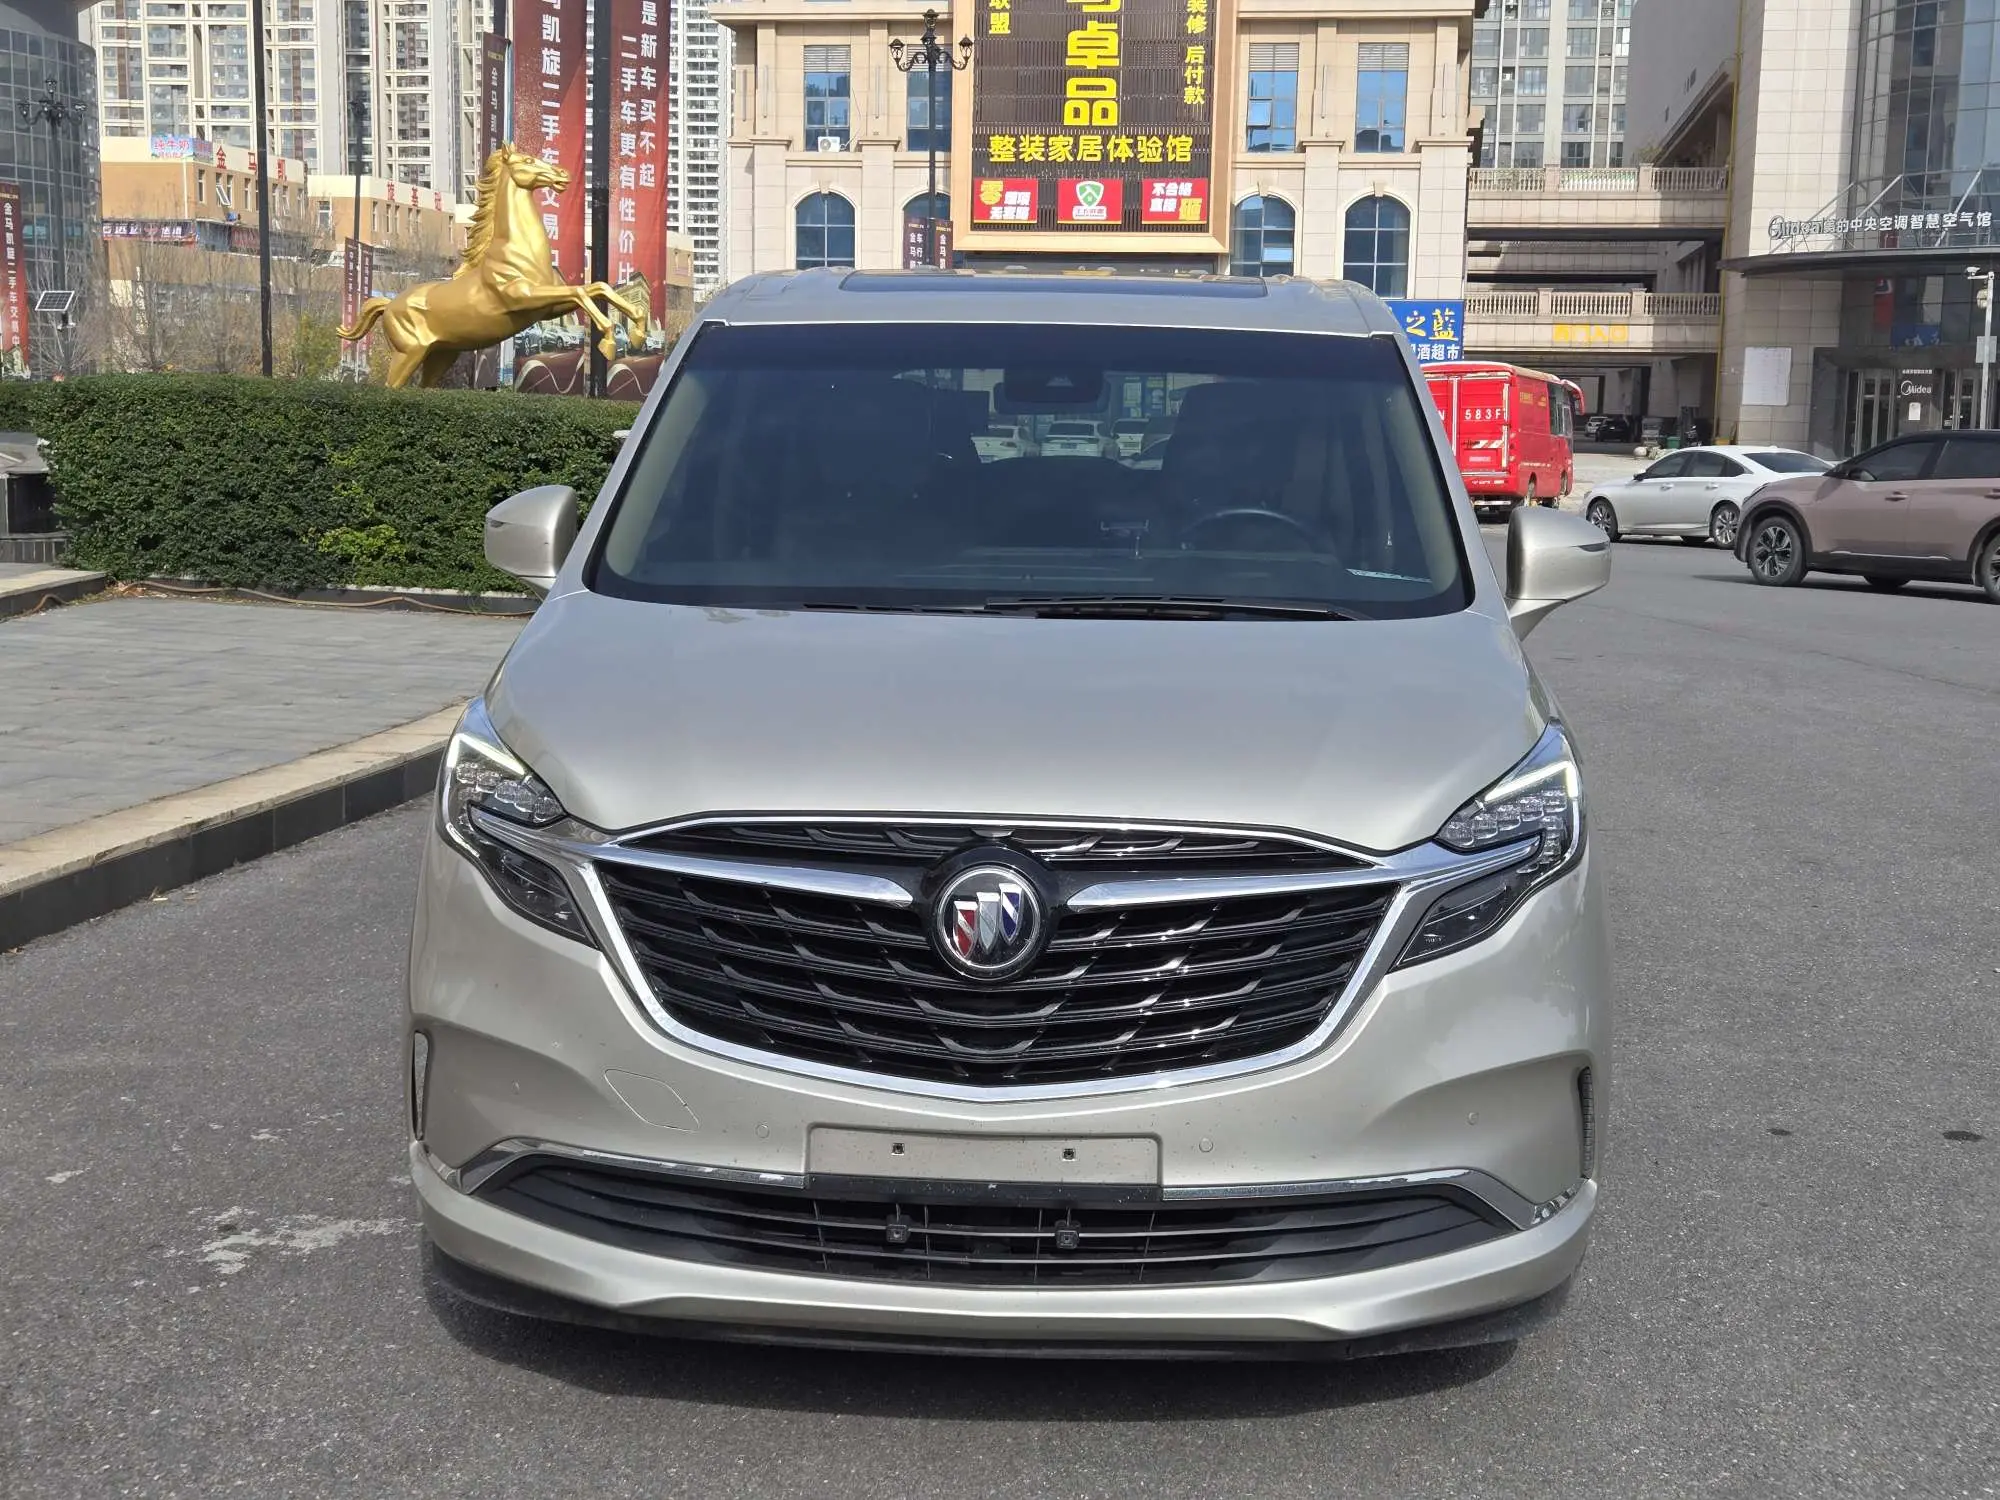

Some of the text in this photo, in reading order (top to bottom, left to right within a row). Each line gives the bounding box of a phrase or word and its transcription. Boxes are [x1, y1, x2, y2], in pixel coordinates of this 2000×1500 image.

[1063, 0, 1121, 126] 卓品
[617, 35, 638, 286] 二手车更有性价比
[989, 134, 1193, 163] 整装家居体验馆
[1900, 380, 1932, 395] Midea
